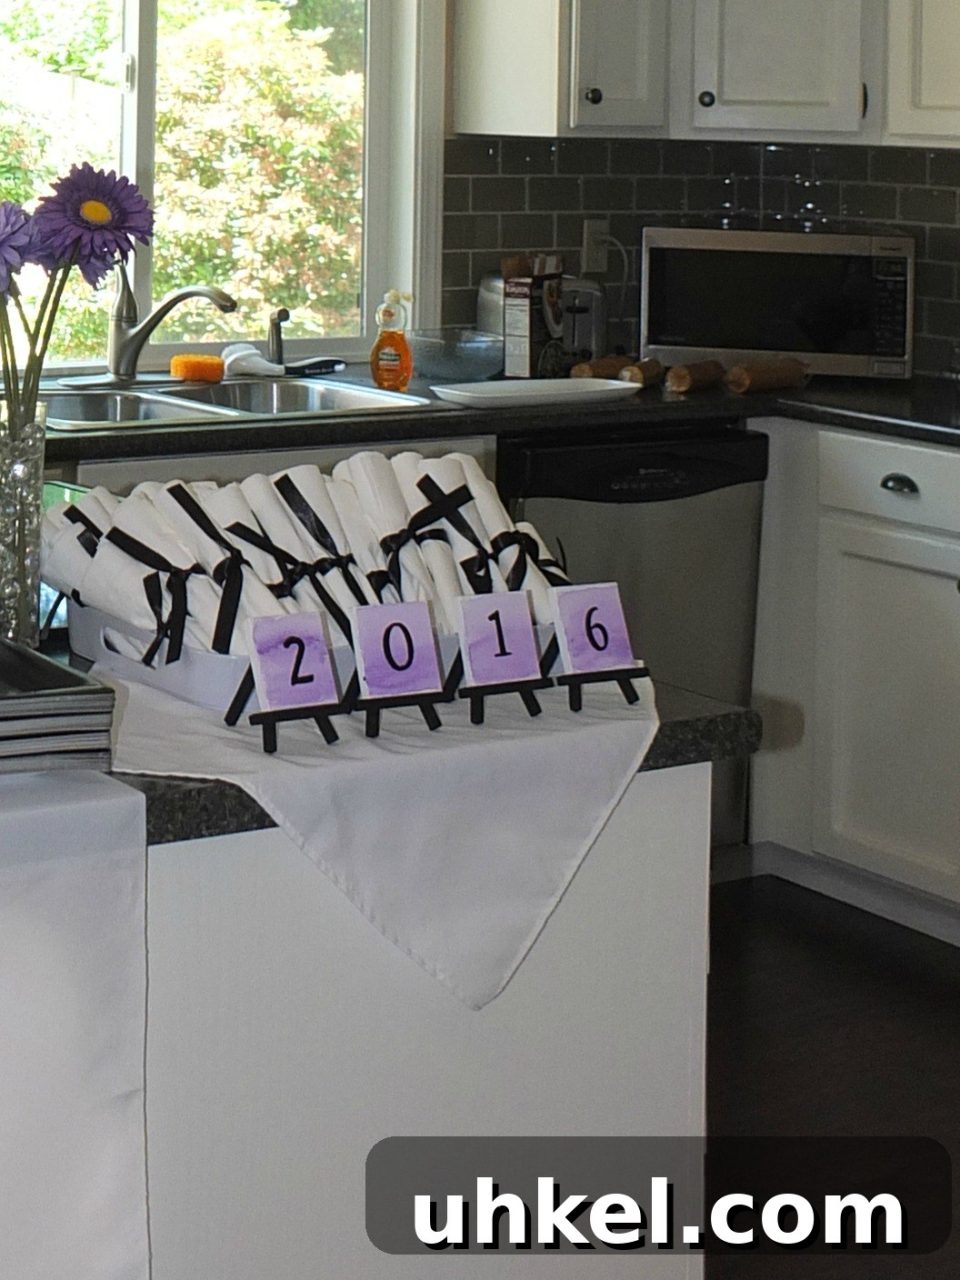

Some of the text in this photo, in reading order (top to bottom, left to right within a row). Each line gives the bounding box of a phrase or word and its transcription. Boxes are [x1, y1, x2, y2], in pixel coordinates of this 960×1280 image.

[283, 606, 608, 686] 2 0 1 6
